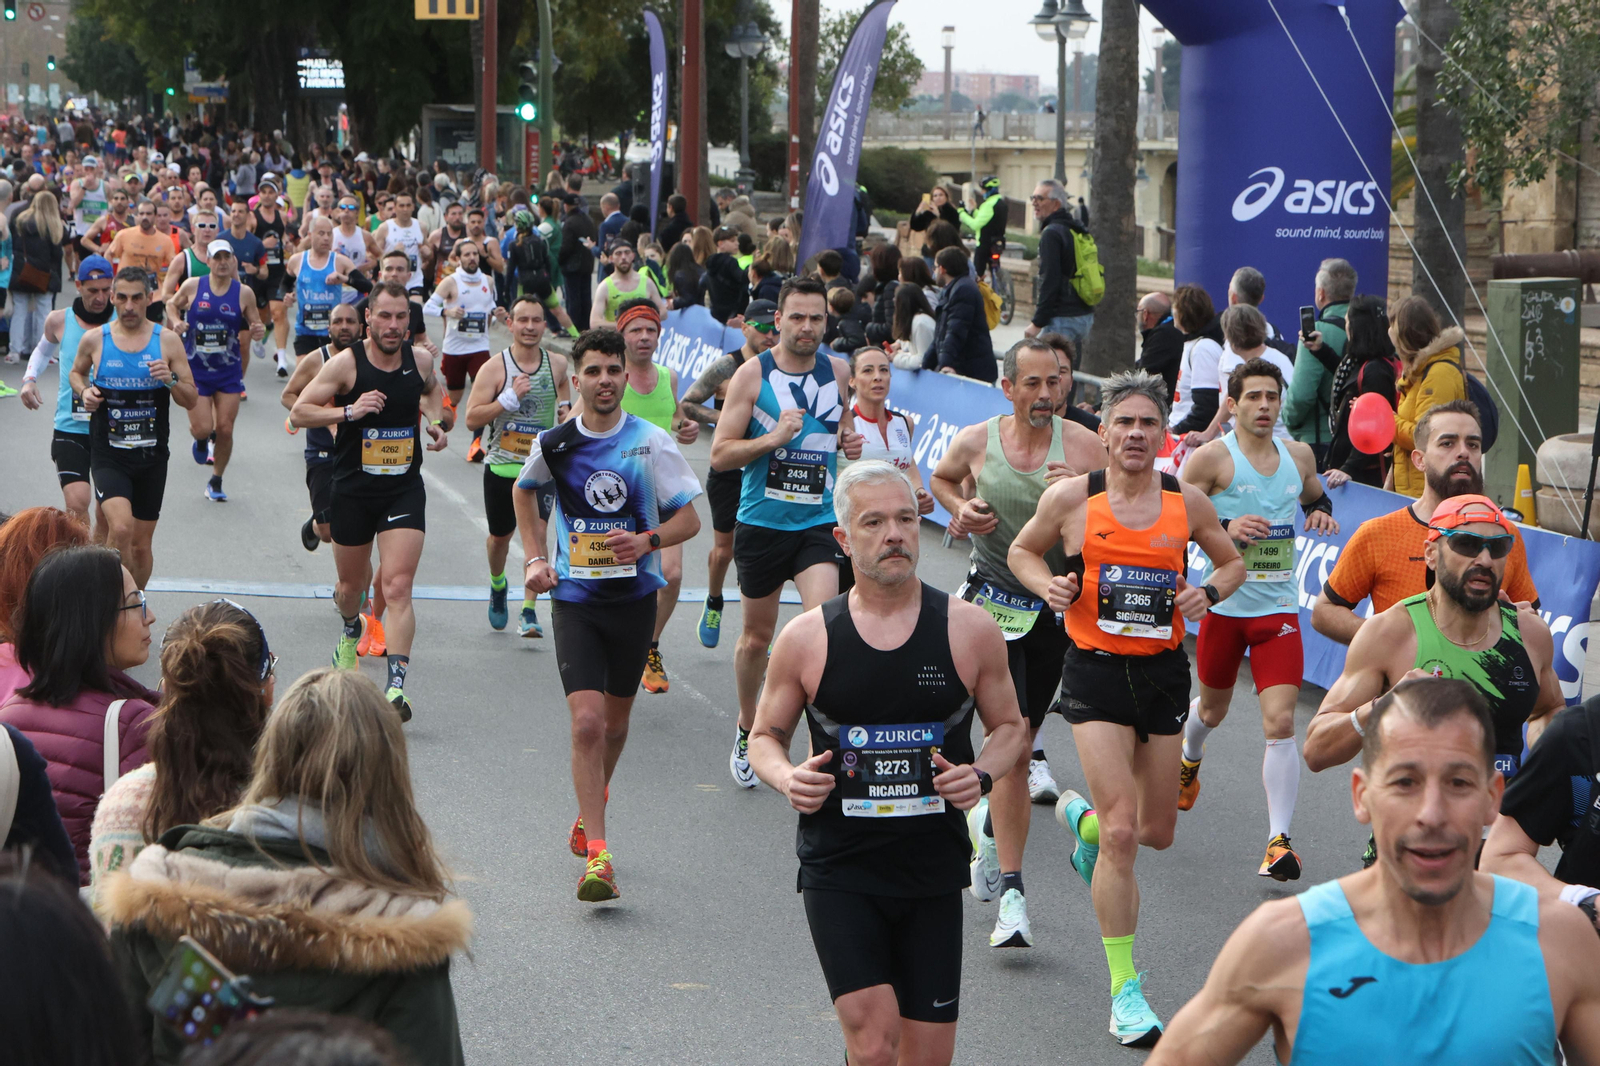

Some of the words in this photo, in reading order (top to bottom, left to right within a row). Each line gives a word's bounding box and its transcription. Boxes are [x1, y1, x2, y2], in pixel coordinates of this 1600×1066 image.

[826, 71, 855, 156] asics
[846, 135, 857, 166] sound
[856, 84, 866, 114] sound
[862, 62, 873, 86] body
[1284, 179, 1378, 215] asics
[1275, 226, 1313, 238] sound
[1313, 226, 1341, 240] mind,
[1343, 227, 1370, 239] sound
[1370, 228, 1385, 242] body
[302, 289, 335, 301] Vizela
[124, 423, 140, 432] 2437
[382, 430, 410, 438] ZURICH
[790, 452, 822, 461] ZURICH
[787, 469, 808, 479] 2434
[783, 482, 791, 490] TE
[792, 484, 810, 492] PLAK
[589, 522, 627, 530] ZURICH
[1269, 528, 1290, 537] URICH
[1259, 547, 1278, 555] 1499
[588, 557, 615, 566] DANIEL
[1127, 570, 1169, 582] ZURICH
[1124, 593, 1151, 606] 2365
[1116, 611, 1155, 623] SIGÜENZA
[875, 729, 931, 743] ZURICH
[875, 760, 910, 775] 3273
[1494, 760, 1511, 771] CH
[868, 784, 919, 797] RICARDO
